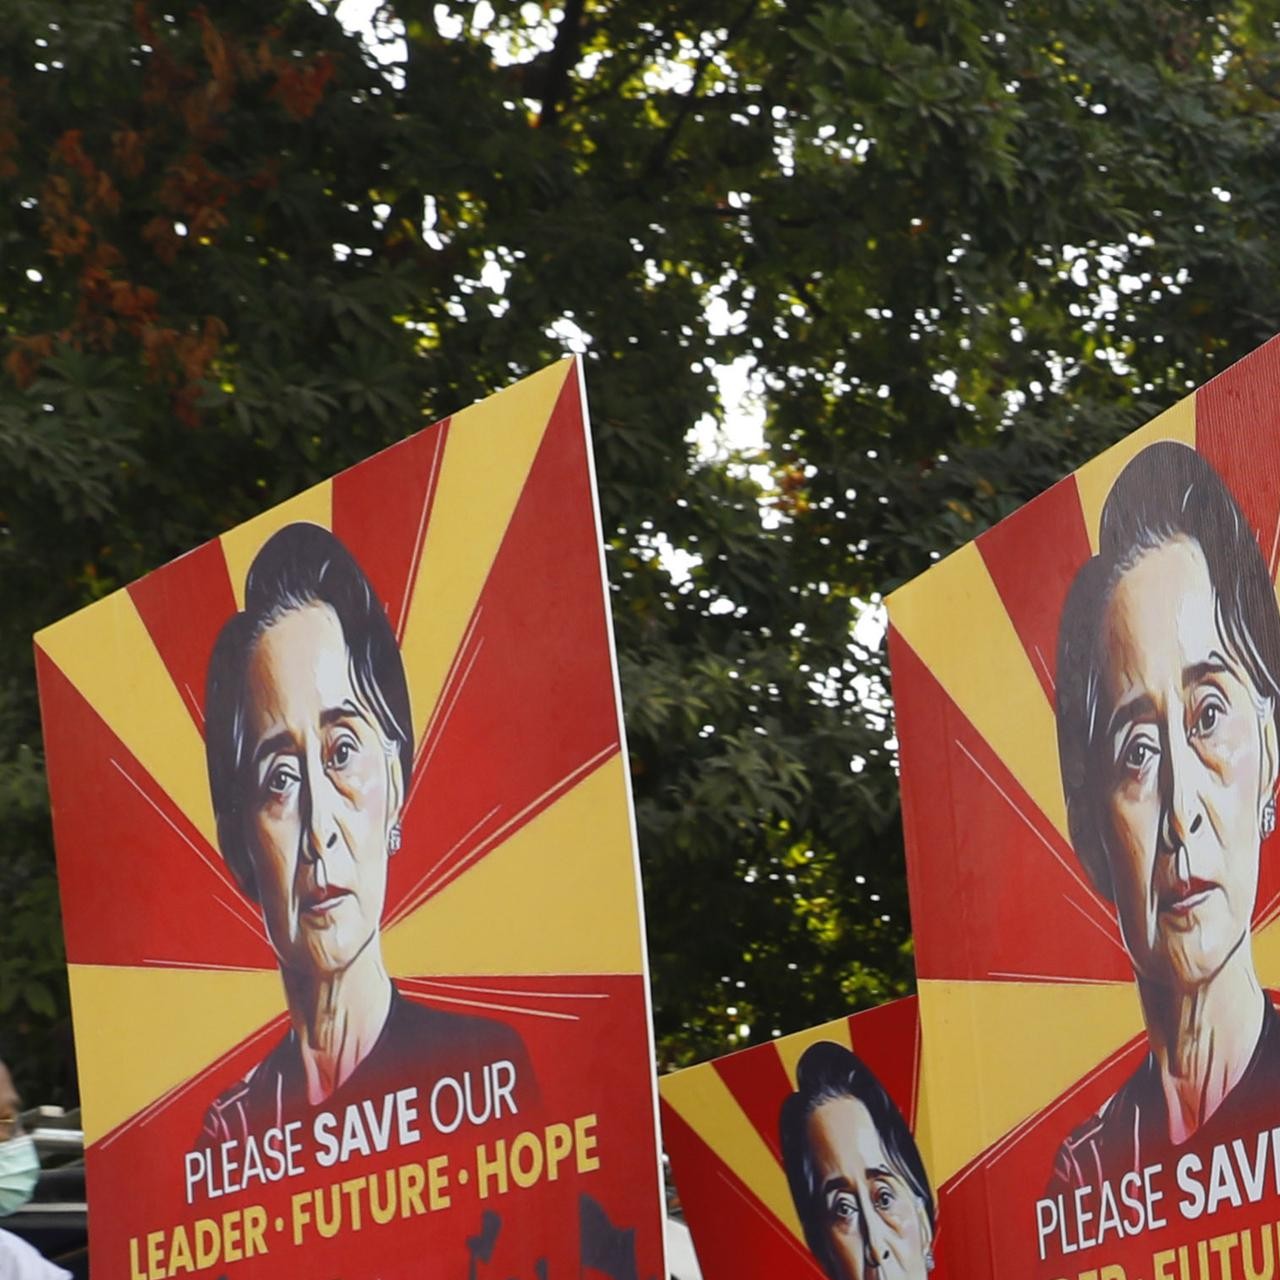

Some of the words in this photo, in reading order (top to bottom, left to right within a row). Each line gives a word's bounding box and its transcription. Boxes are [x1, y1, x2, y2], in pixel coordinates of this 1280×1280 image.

[185, 1122, 304, 1204] PLEASE
[313, 1087, 420, 1166] SAVE
[430, 1059, 518, 1133] OUR
[291, 1155, 451, 1246] FUTURE
[476, 1113, 600, 1200] HOPE
[1036, 1163, 1166, 1259] PLEASE
